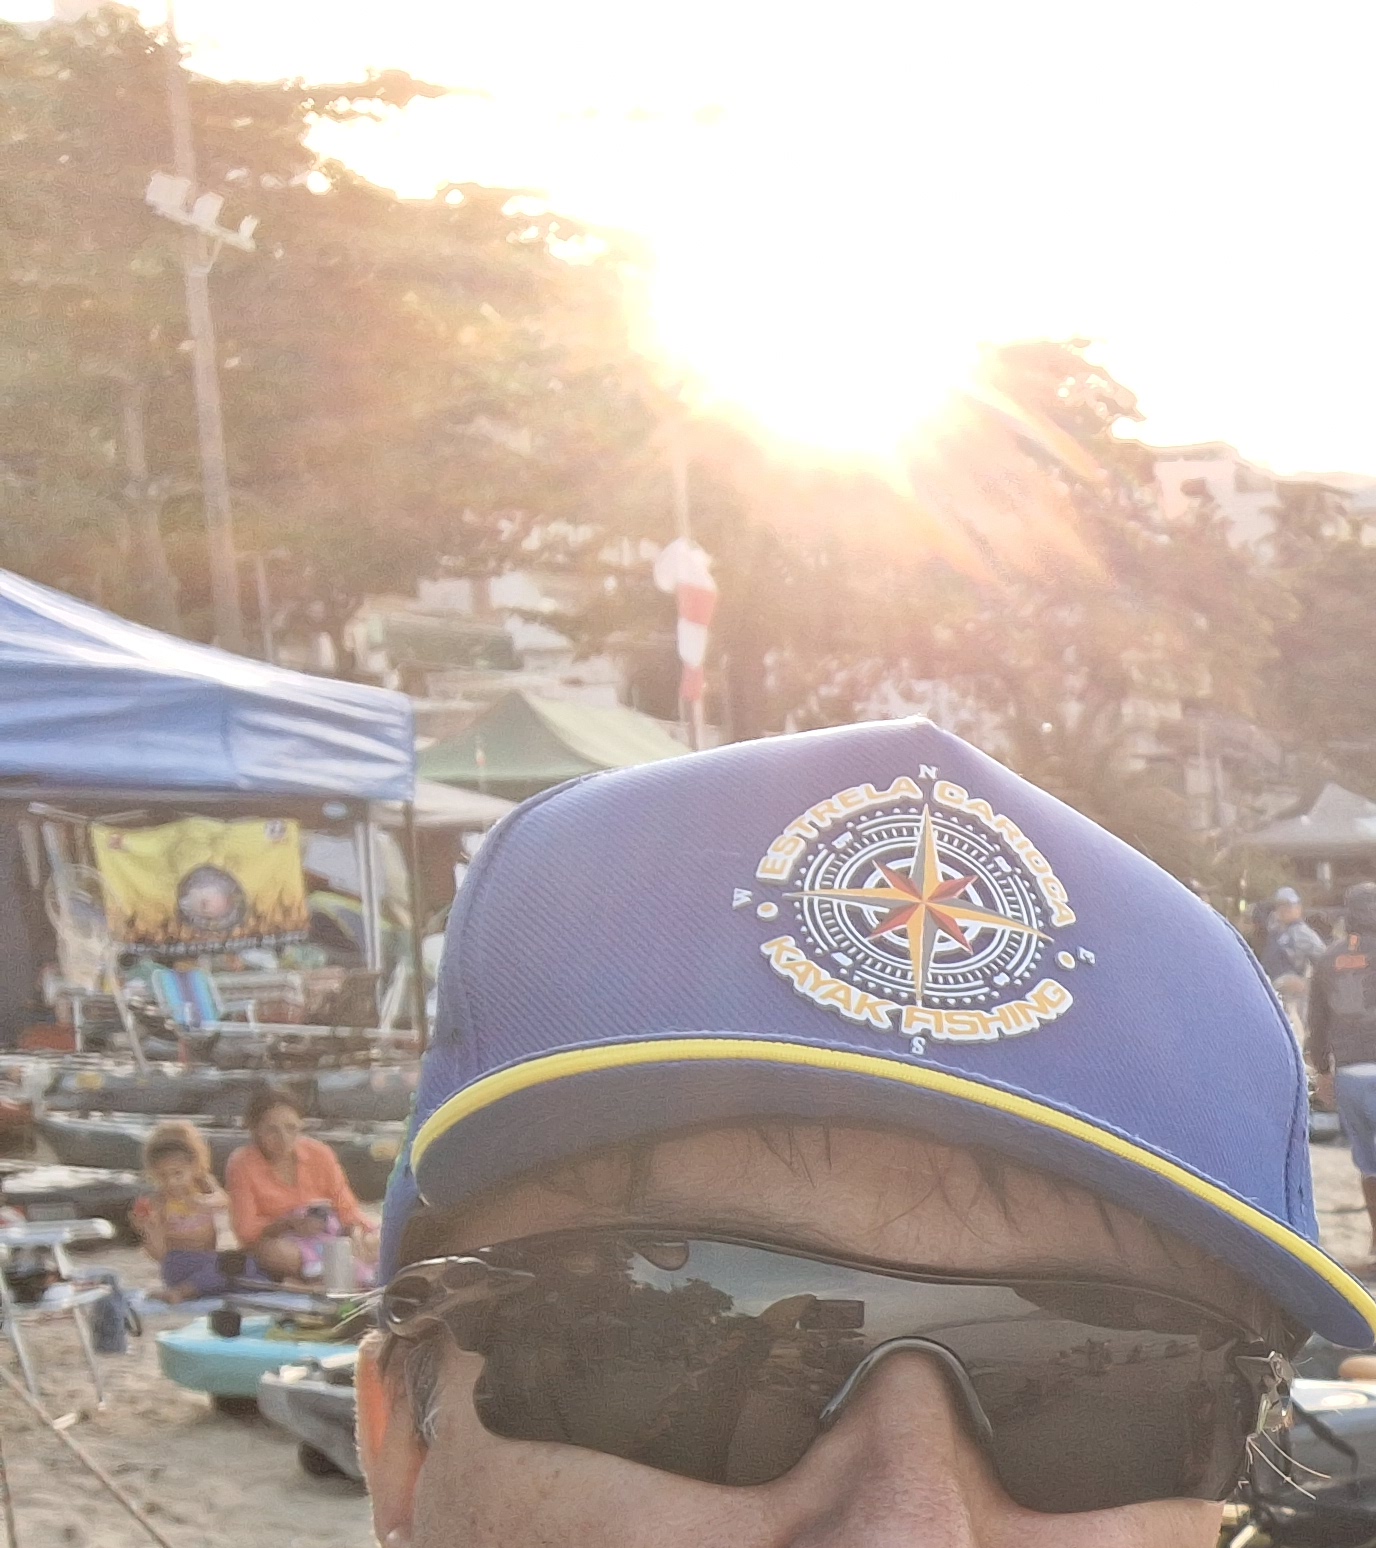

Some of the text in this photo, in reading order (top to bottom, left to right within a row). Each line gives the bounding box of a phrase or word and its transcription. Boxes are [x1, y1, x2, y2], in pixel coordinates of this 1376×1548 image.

[919, 764, 939, 780] N
[756, 776, 1076, 927] ESTRELA CARIOCA
[732, 887, 753, 909] W
[760, 935, 1073, 1043] KAYAK FISHING
[910, 1036, 927, 1055] S
